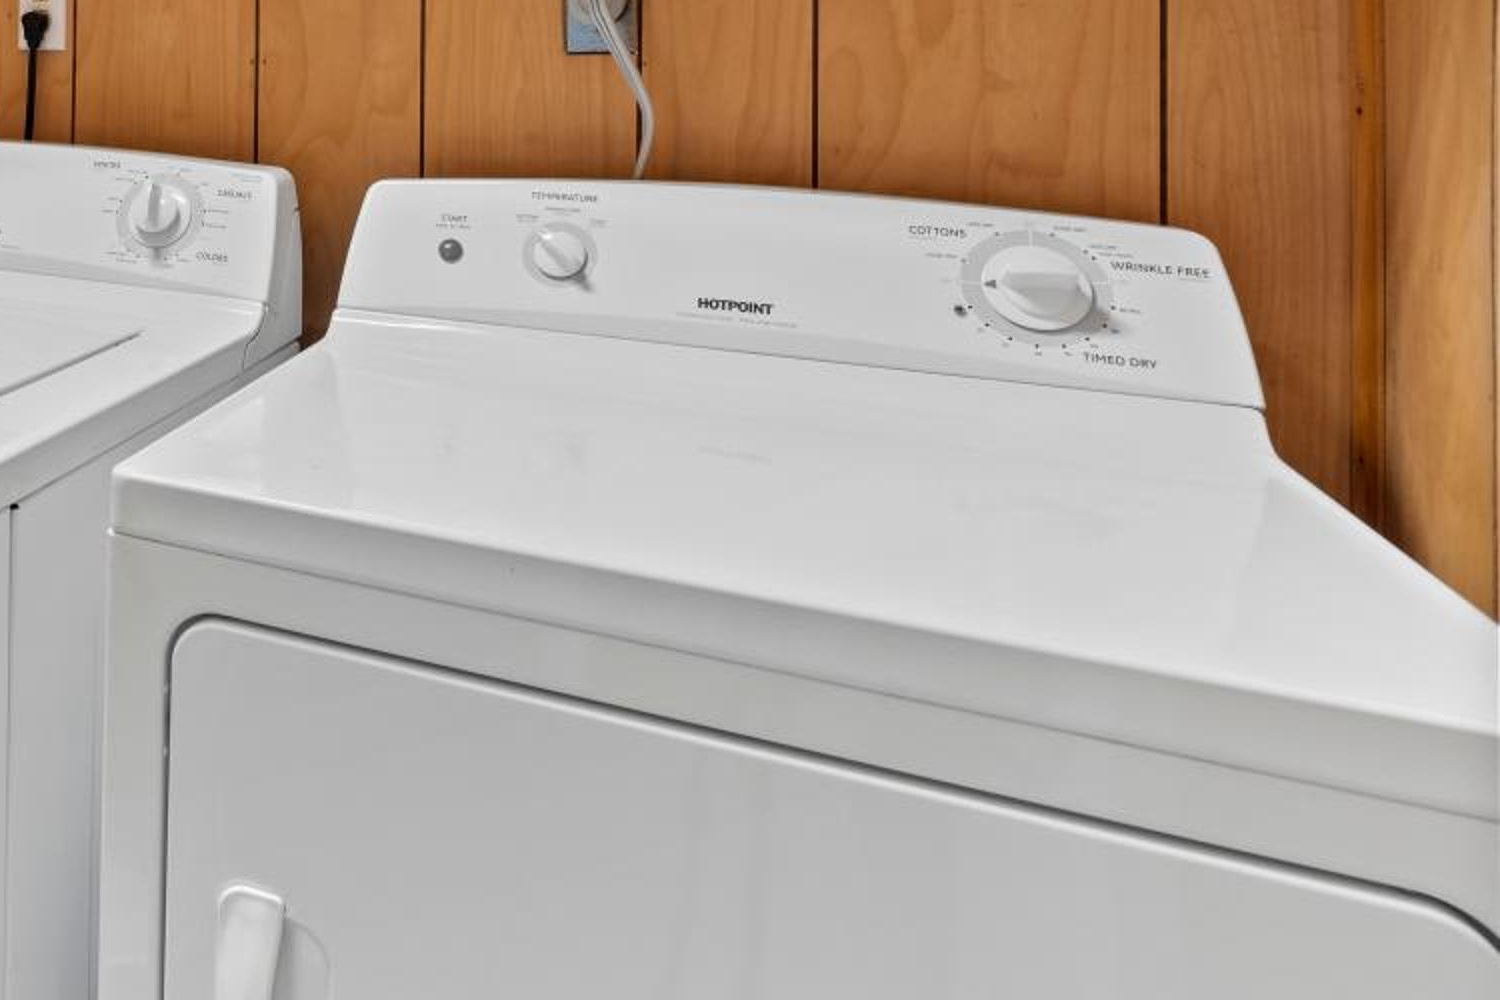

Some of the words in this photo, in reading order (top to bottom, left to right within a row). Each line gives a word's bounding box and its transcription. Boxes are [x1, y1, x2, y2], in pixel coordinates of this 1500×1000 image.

[908, 225, 967, 239] COTTONS
[1110, 261, 1172, 276] WRINKLE
[1177, 266, 1210, 279] FREE
[697, 297, 773, 315] HOTPOINT
[1083, 351, 1126, 367] TIMED
[1129, 357, 1158, 369] DRY
